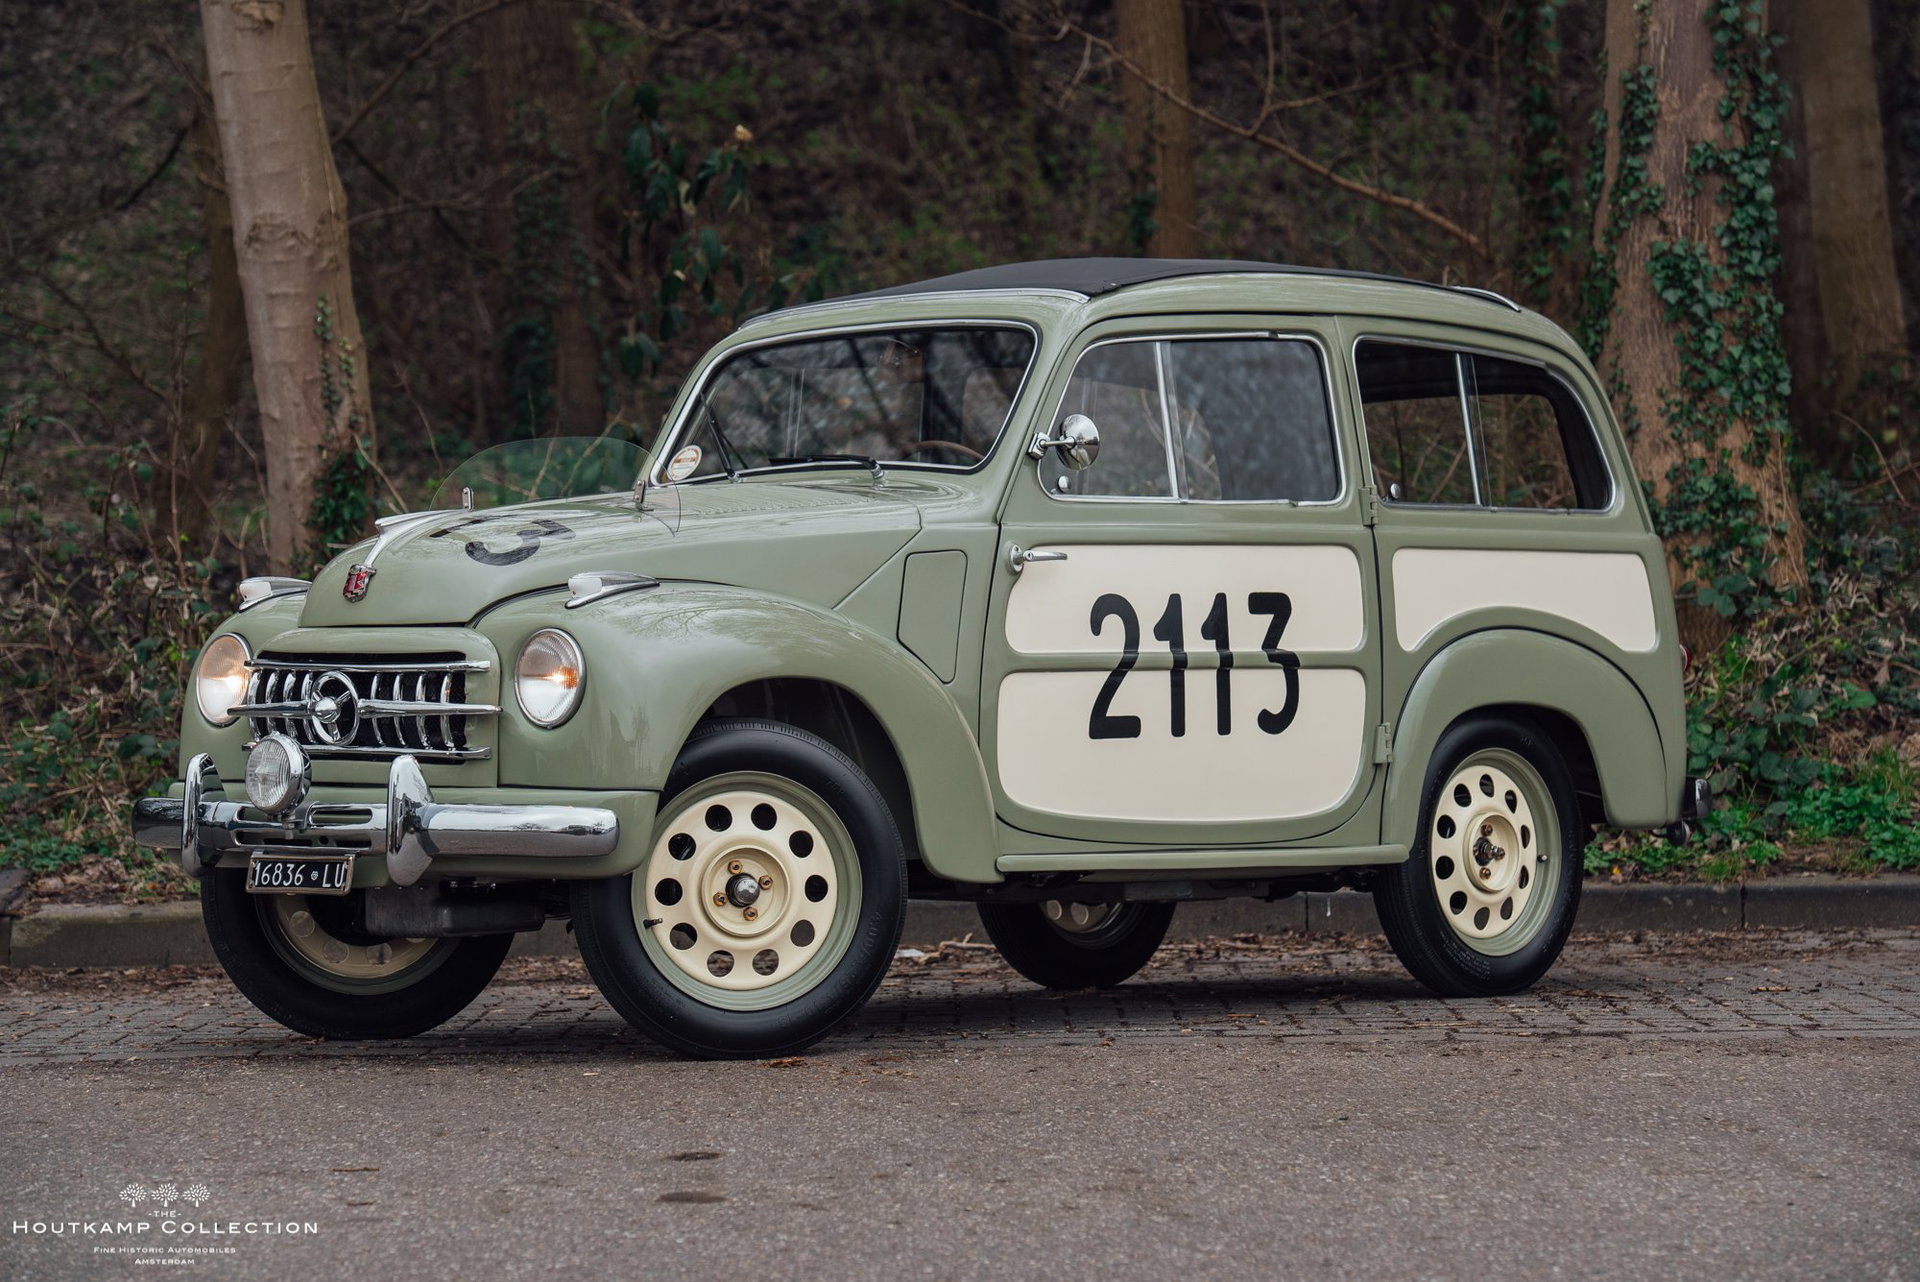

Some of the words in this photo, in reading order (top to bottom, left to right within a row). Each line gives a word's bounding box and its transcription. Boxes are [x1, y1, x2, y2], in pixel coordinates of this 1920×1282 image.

[1089, 592, 1300, 739] 2113
[254, 862, 306, 887] 16836
[322, 863, 346, 888] LU
